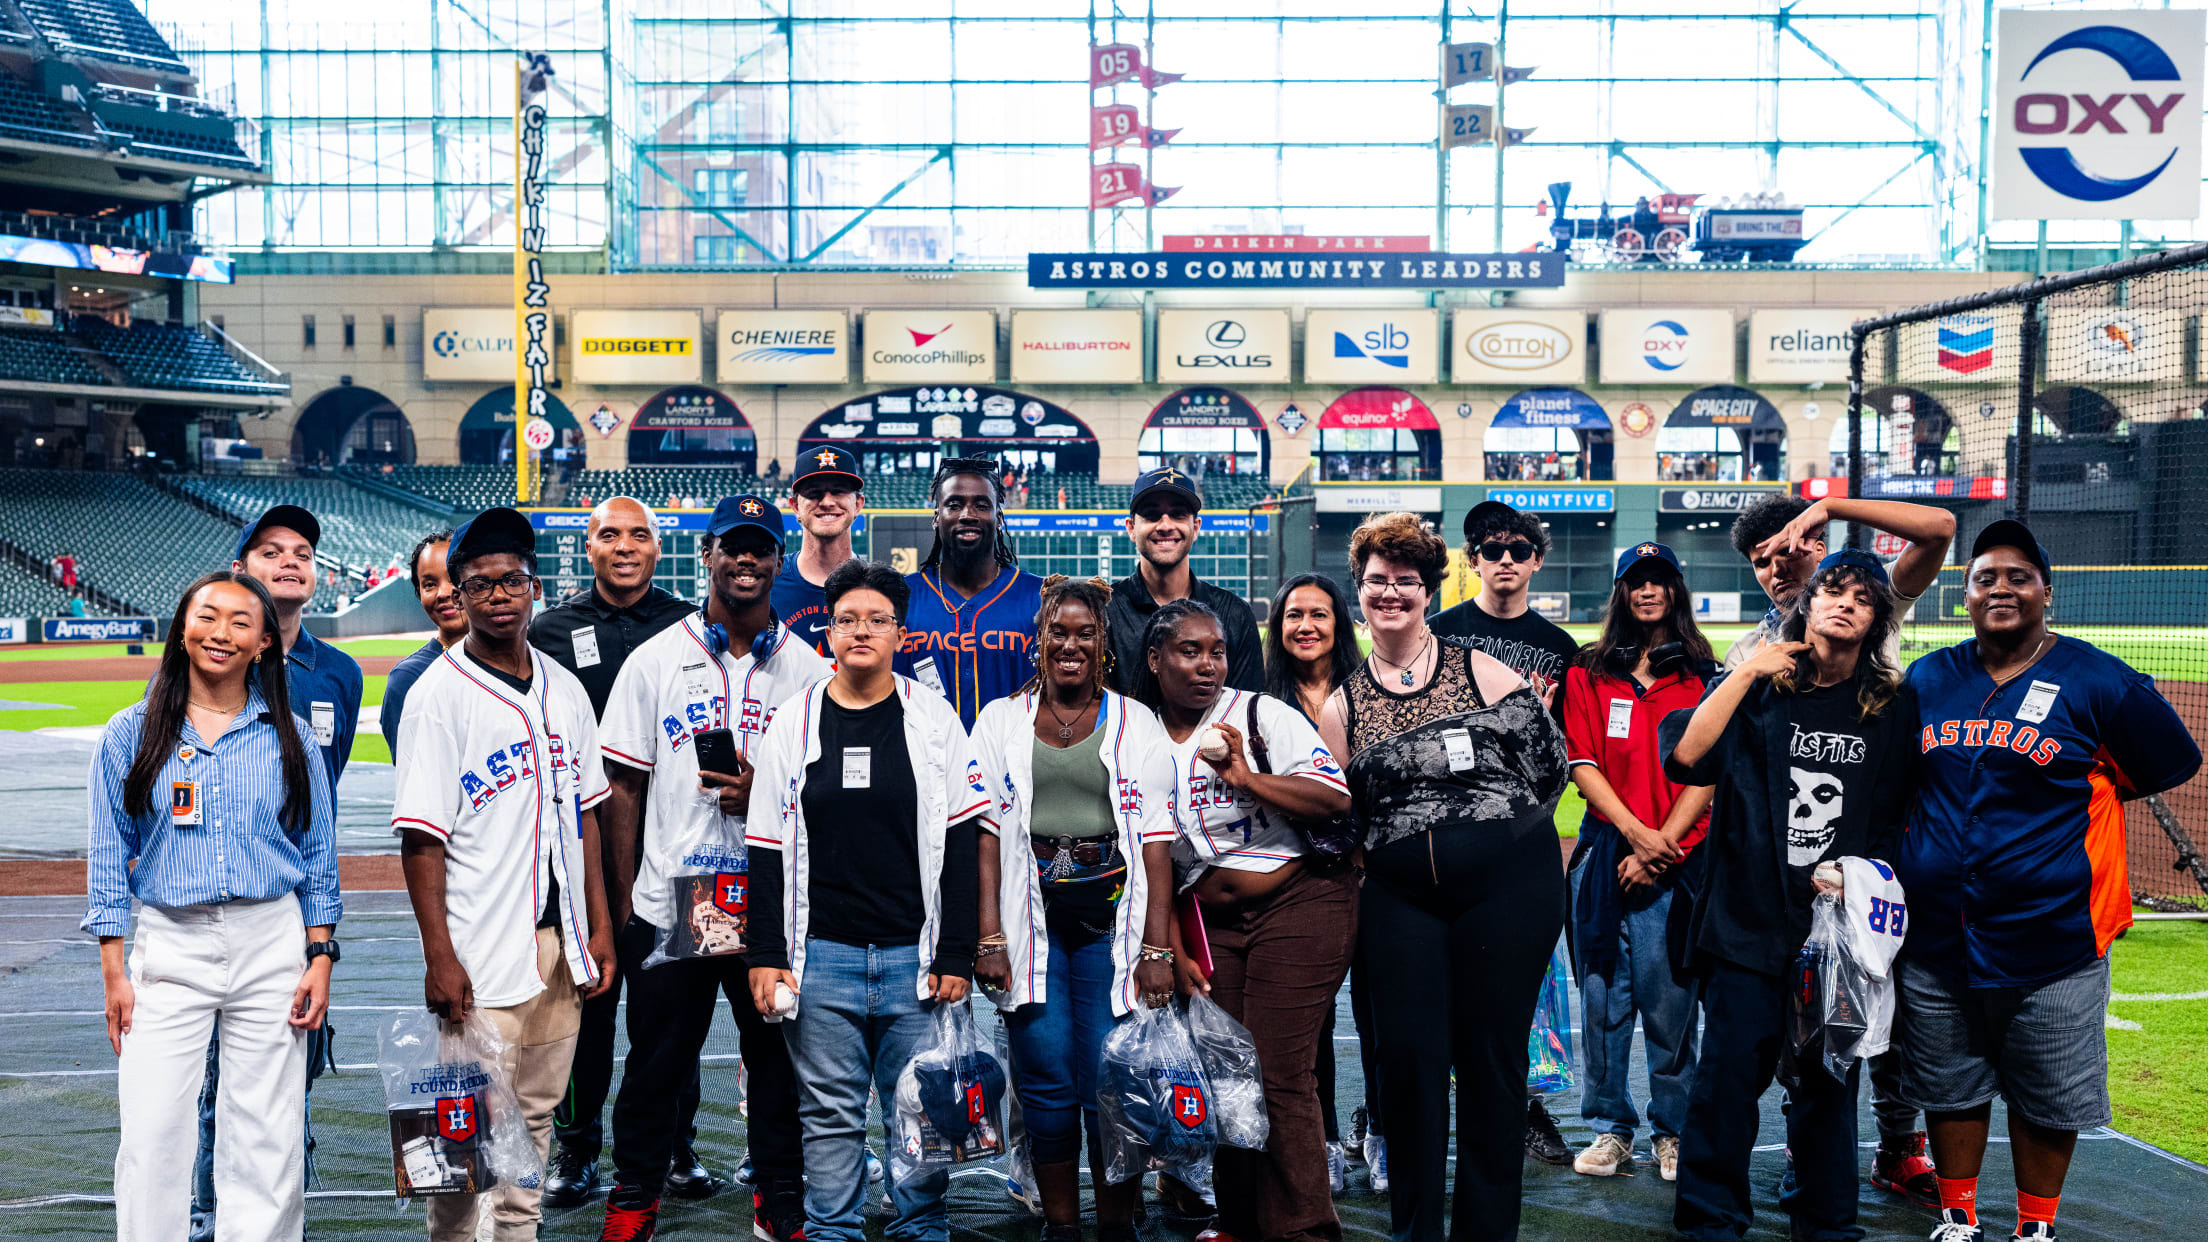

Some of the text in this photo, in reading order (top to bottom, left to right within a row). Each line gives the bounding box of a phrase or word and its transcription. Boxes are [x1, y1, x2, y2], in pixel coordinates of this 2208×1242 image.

[1100, 51, 1130, 76] 05
[1456, 51, 1483, 75] 17
[2013, 93, 2186, 135] OXY
[1102, 114, 1130, 137] 19
[1453, 114, 1481, 136] 22
[1100, 171, 1127, 194] 21
[1194, 237, 1387, 249] DAIKIN PARK
[1050, 261, 1543, 280] ASTROS COMMUNITY LEADERS
[461, 337, 515, 354] CALPI
[731, 330, 836, 345] CHENIERE
[1364, 323, 1409, 351] slb
[1644, 339, 1687, 352] OXY
[1770, 329, 1852, 351] reliant
[585, 340, 689, 354] DOGGETT
[1023, 341, 1131, 351] HALLIBURTON
[1479, 333, 1557, 360] COTTON
[524, 312, 549, 417] FAIR
[873, 350, 986, 367] ConocoPhillips
[1177, 355, 1272, 368] LEXUS
[1519, 397, 1571, 413] planet
[1690, 399, 1758, 417] SPACE CITY
[648, 417, 702, 426] CRAWFORD
[1162, 417, 1217, 426] CRAWFORD
[1342, 412, 1388, 425] equinor
[1525, 410, 1581, 425] fitness
[1495, 493, 1607, 507] 1POINTFIVE
[557, 536, 576, 545] LAD
[55, 621, 142, 639] AmegyBank
[903, 629, 1033, 654] SPACE CITY
[1921, 718, 2062, 767] ASTROS
[1312, 755, 1336, 768] OXY
[968, 771, 983, 784] OX
[448, 1109, 468, 1131] H
